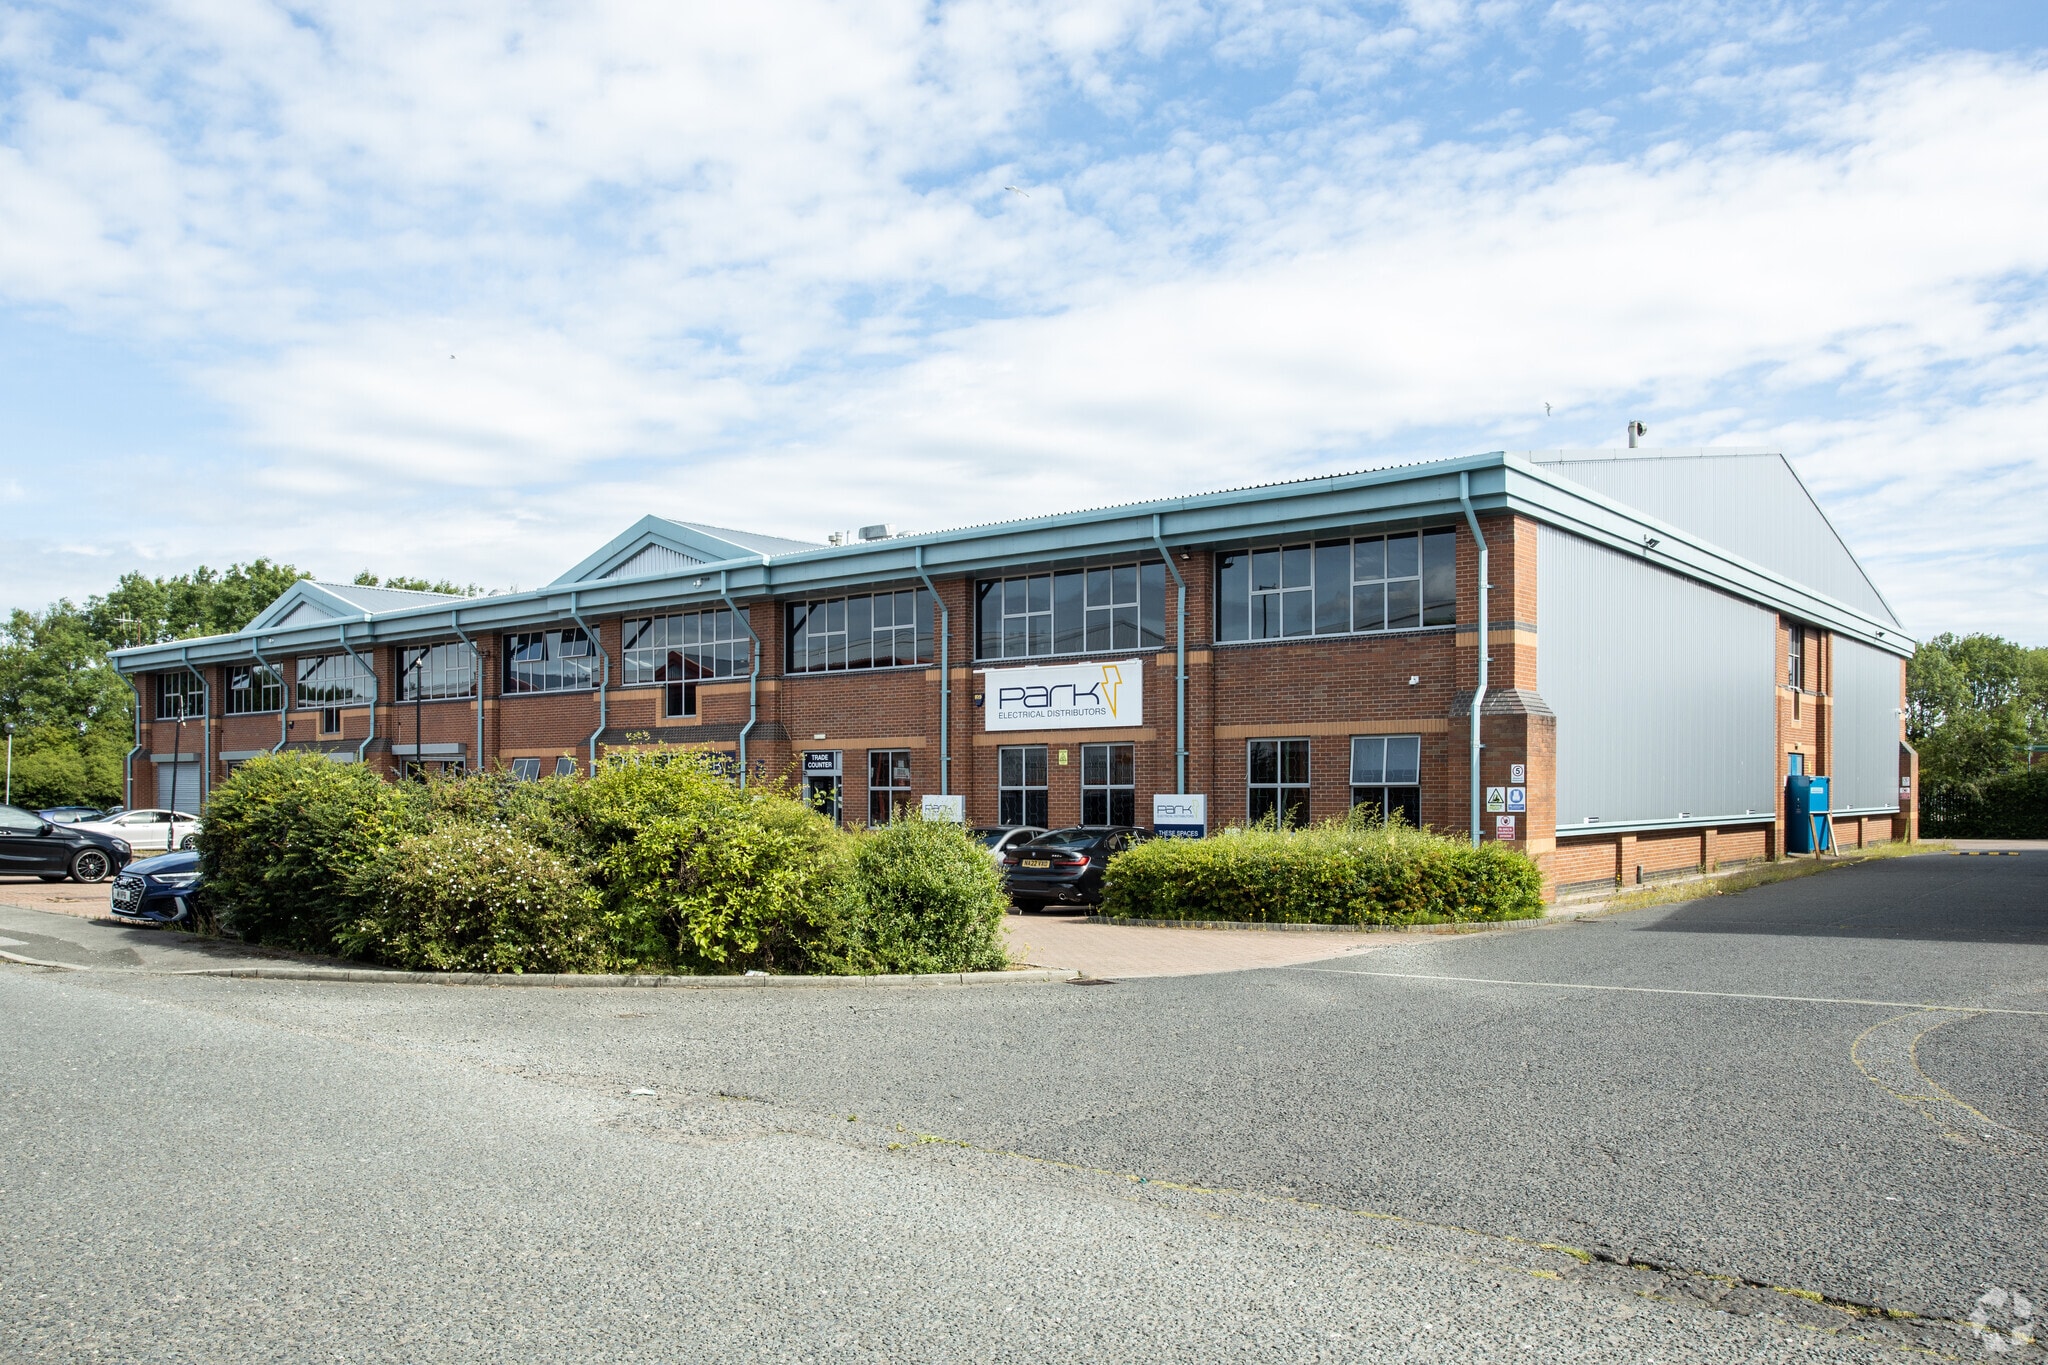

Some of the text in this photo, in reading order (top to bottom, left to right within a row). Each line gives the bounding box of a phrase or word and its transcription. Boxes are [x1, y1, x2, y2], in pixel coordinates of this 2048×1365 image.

[998, 707, 1107, 719] ELECTRICAL DISTRIBUTORS
[807, 761, 833, 769] COUNTER
